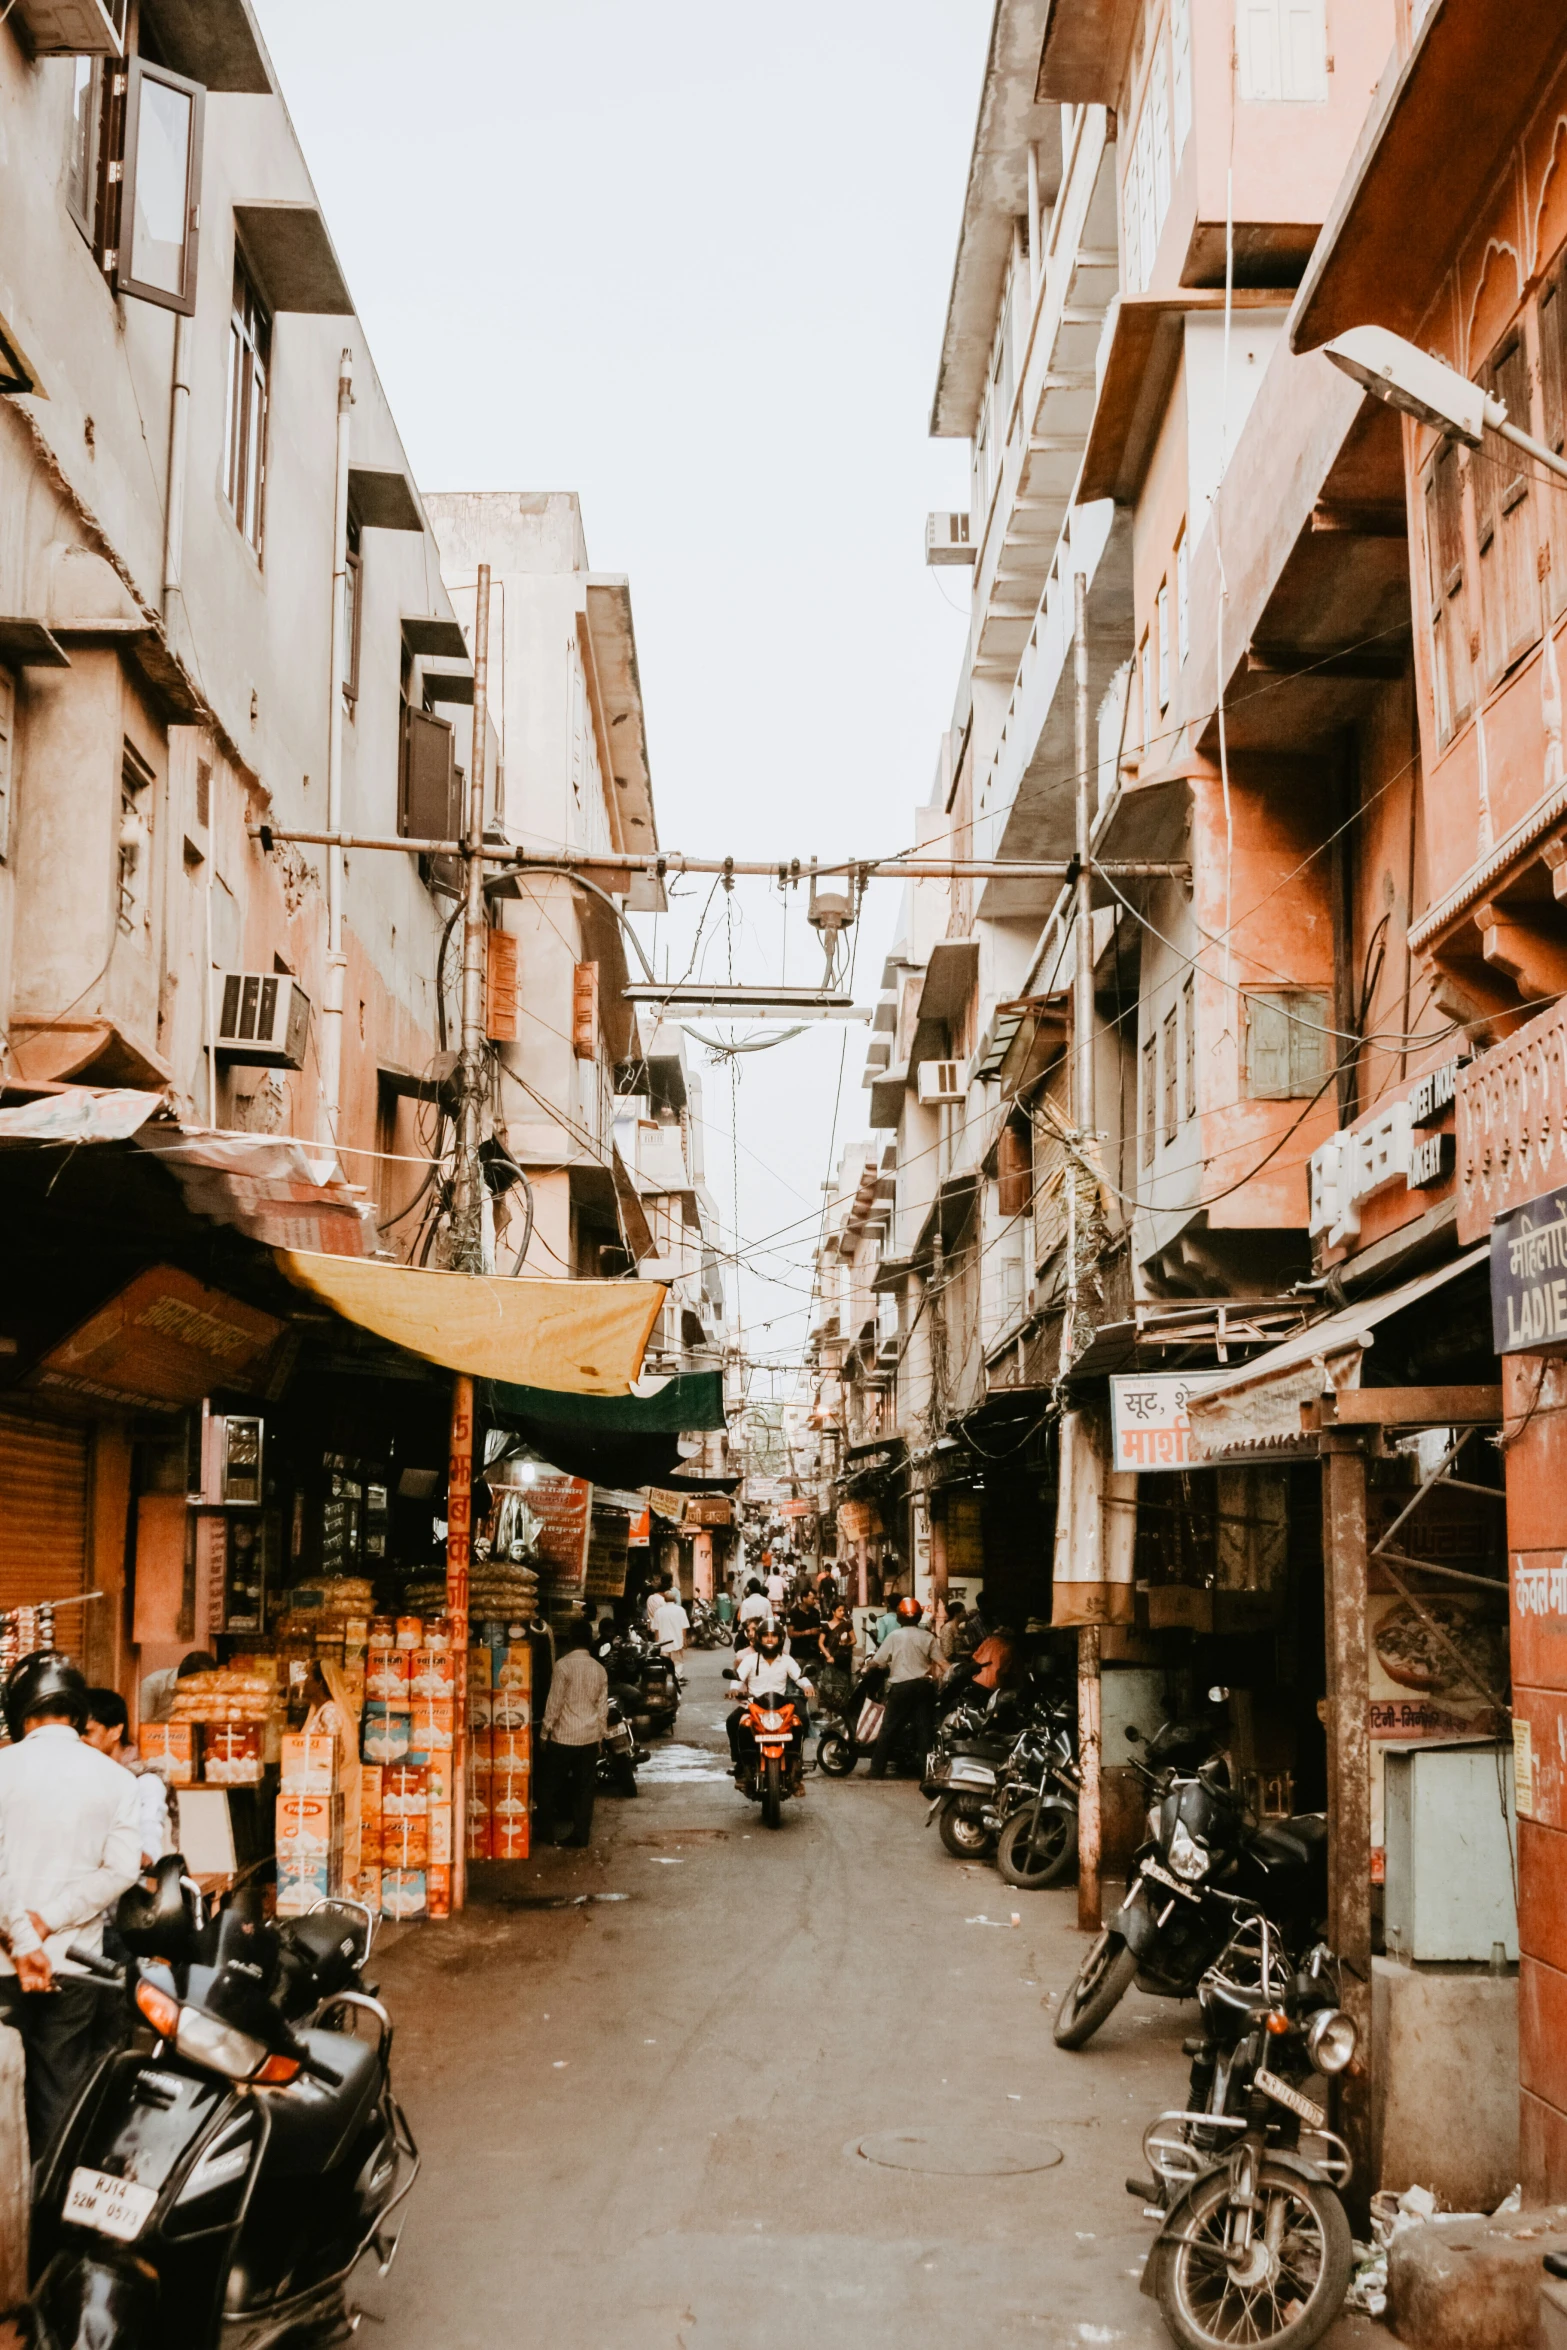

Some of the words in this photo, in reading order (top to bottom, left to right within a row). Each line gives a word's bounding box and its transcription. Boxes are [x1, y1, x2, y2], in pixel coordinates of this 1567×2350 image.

[1507, 1278, 1567, 1346] LADIE
[1123, 1392, 1165, 1419] सूट,
[1175, 1383, 1199, 1410] शे
[1121, 1414, 1199, 1464] मार्श
[1515, 1553, 1549, 1617] केवल
[137, 2069, 184, 2093] HONDA
[94, 2177, 129, 2200] RJ14
